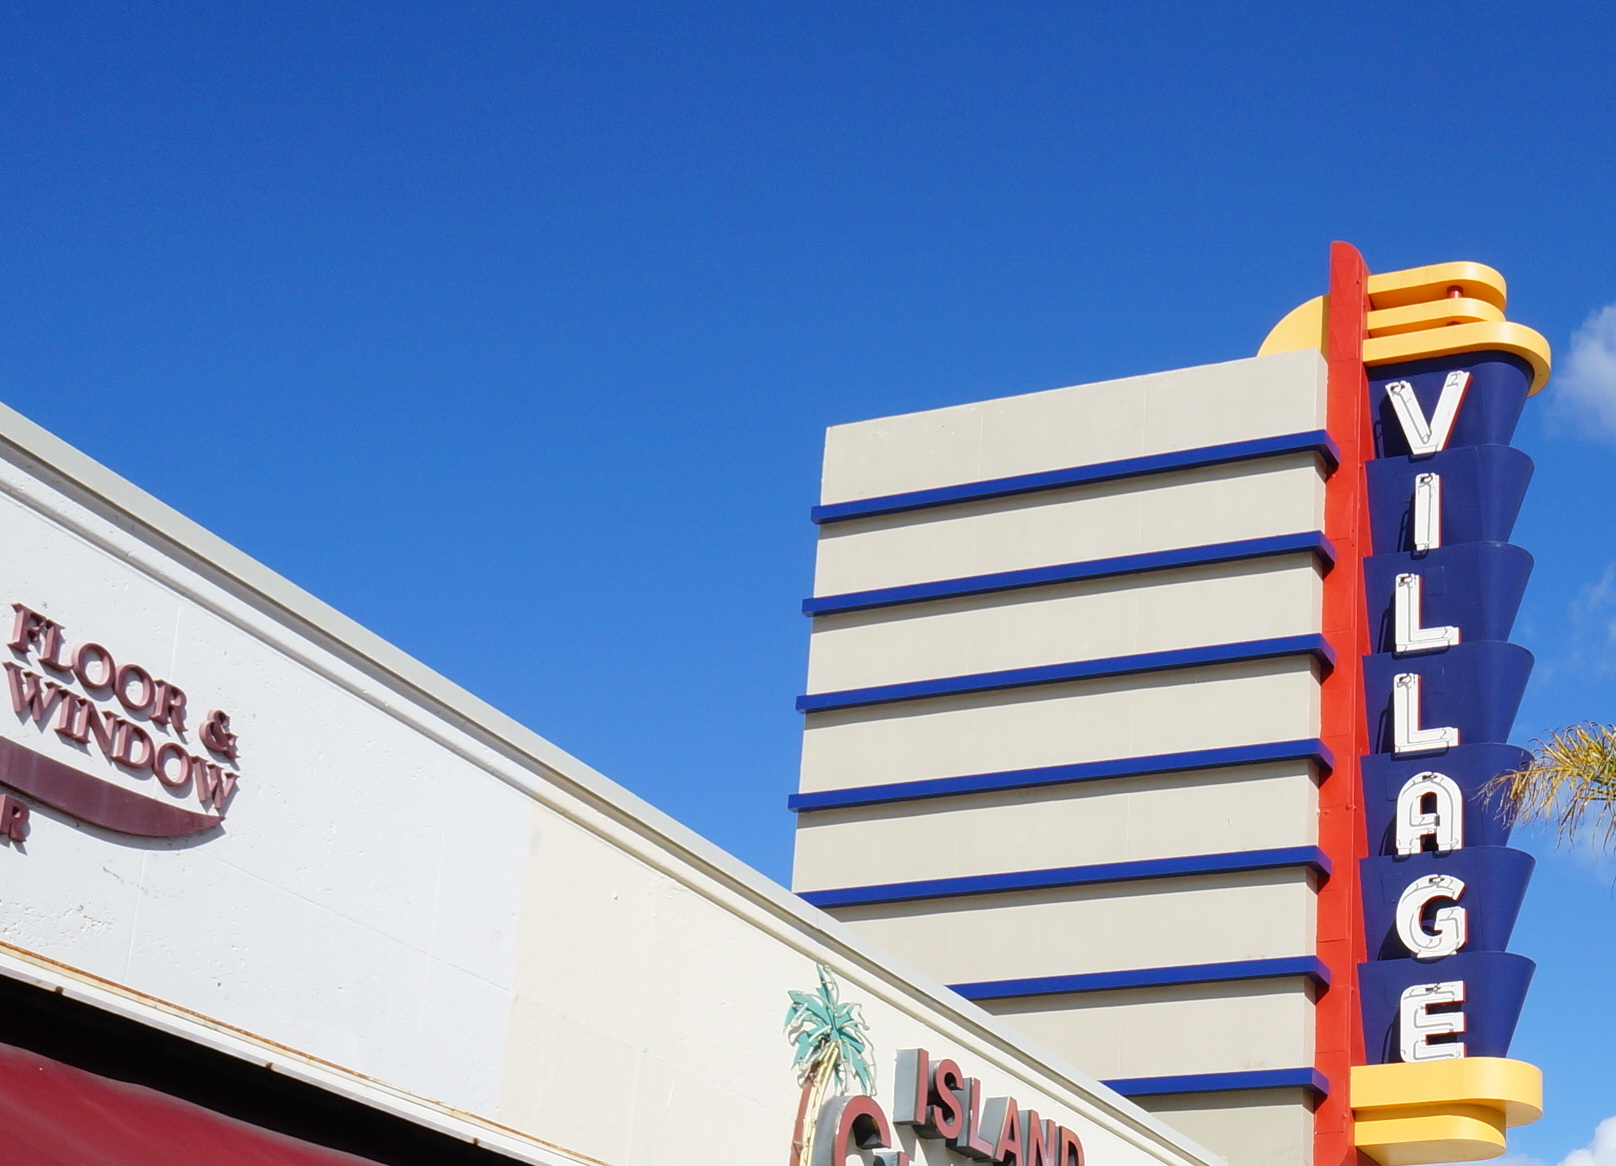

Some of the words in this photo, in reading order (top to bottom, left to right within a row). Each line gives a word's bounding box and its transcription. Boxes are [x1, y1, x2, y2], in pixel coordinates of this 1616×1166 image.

[2, 660, 241, 810] WINDOW
[7, 602, 188, 734] FLOOR
[199, 709, 241, 760] &
[1385, 370, 1473, 1064] VILLAGE
